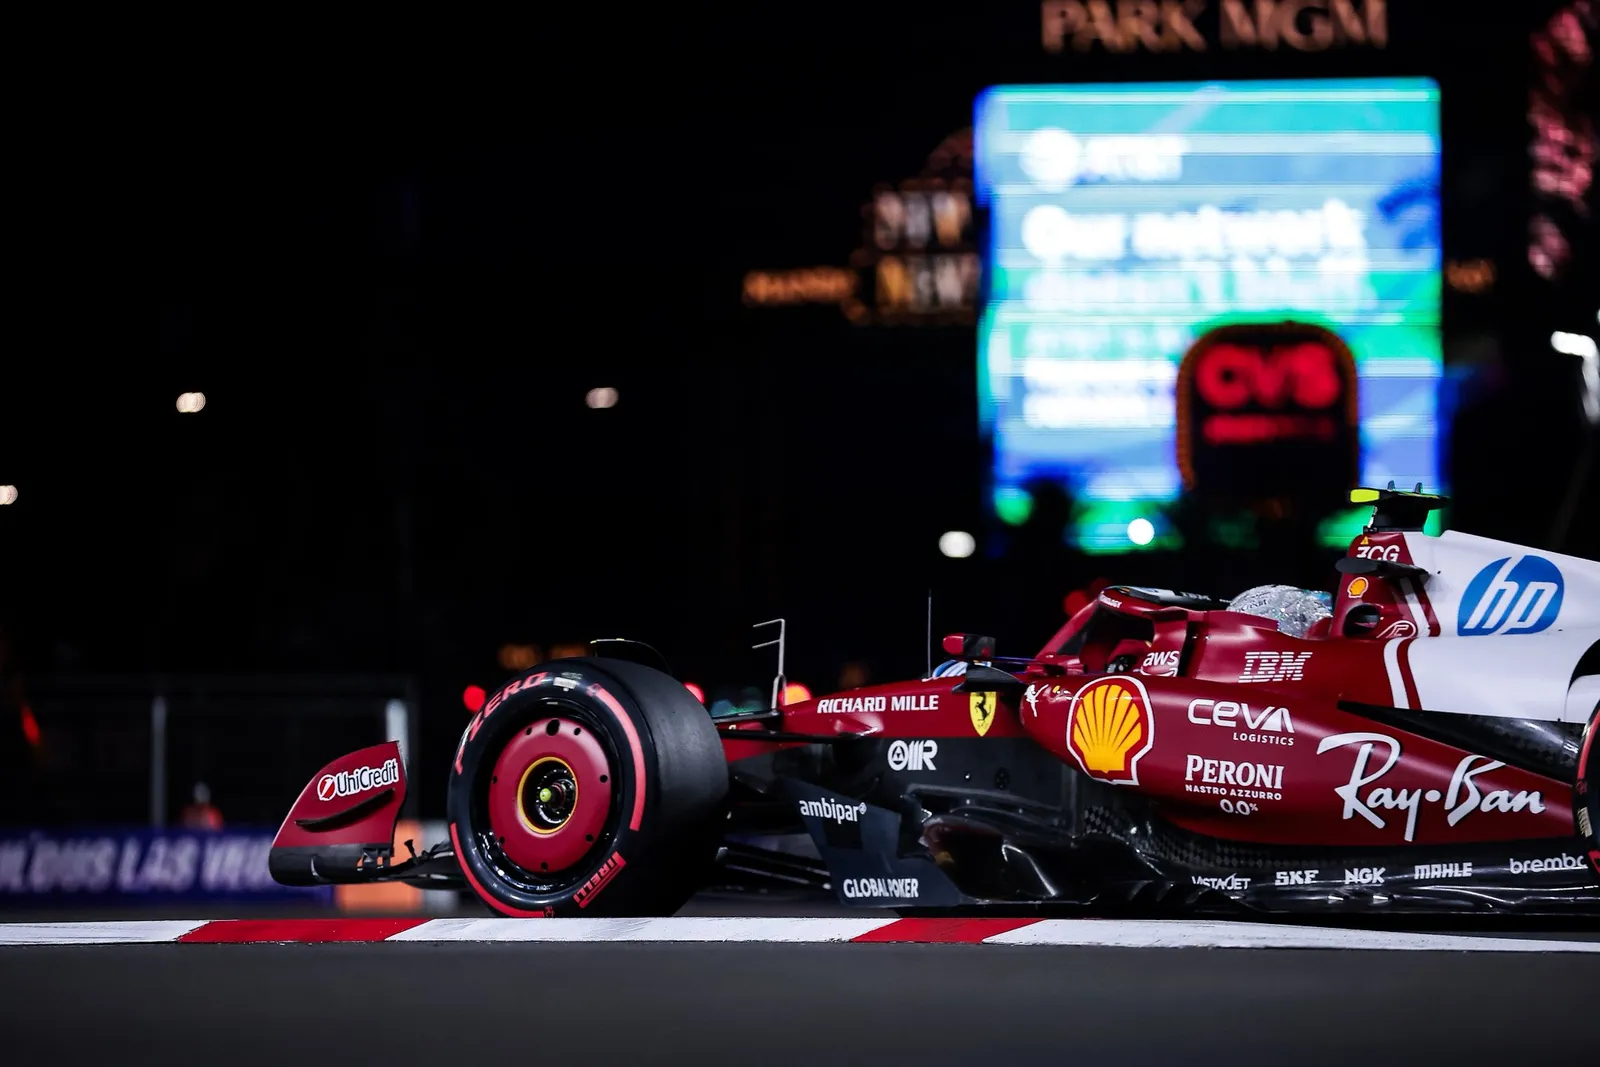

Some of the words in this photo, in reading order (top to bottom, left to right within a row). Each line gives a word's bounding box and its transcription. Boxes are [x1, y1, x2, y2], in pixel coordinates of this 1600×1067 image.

[1041, 0, 1206, 52] PARK
[1220, 0, 1387, 51] MGM
[1202, 345, 1338, 407] CVS
[1463, 555, 1558, 634] hp
[1142, 651, 1180, 667] aws
[1238, 651, 1313, 683] IBM
[817, 696, 887, 714] RICHARD
[891, 695, 939, 711] MILLE
[1233, 732, 1294, 746] LOGISTICS
[337, 761, 397, 794] UniCredit
[1185, 754, 1285, 789] PERONI
[1185, 784, 1227, 796] NASTRO
[1230, 788, 1282, 801] AZZURRO
[1275, 869, 1319, 886] SKF
[1344, 867, 1386, 885] NGK
[1414, 862, 1473, 880] MAHLE
